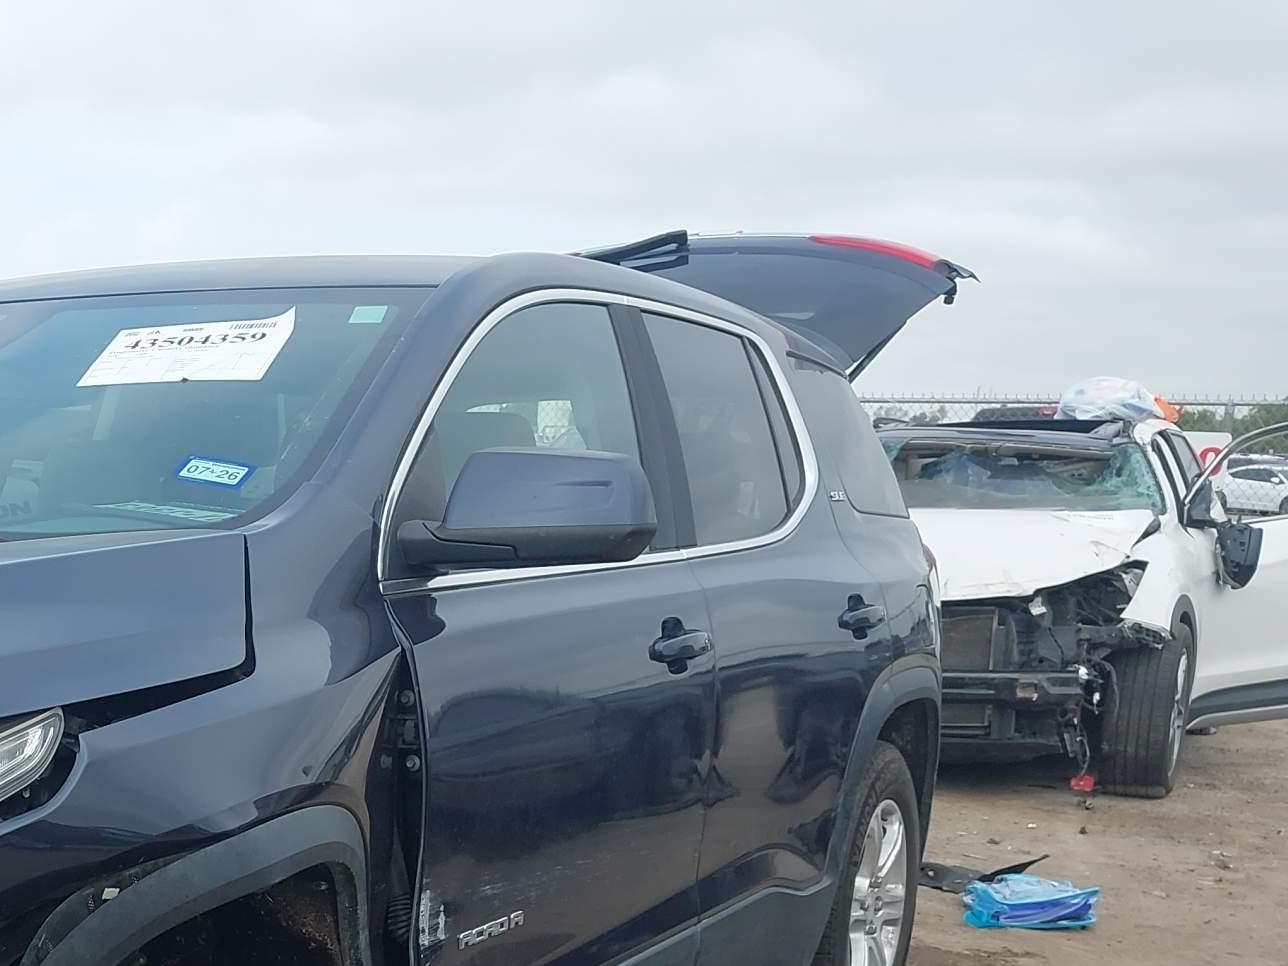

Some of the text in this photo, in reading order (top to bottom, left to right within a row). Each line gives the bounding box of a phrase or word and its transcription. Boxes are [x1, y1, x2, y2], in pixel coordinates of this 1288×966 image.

[124, 331, 268, 351] 43504359
[186, 464, 241, 481] 07 26
[457, 910, 525, 951] ACADIA
